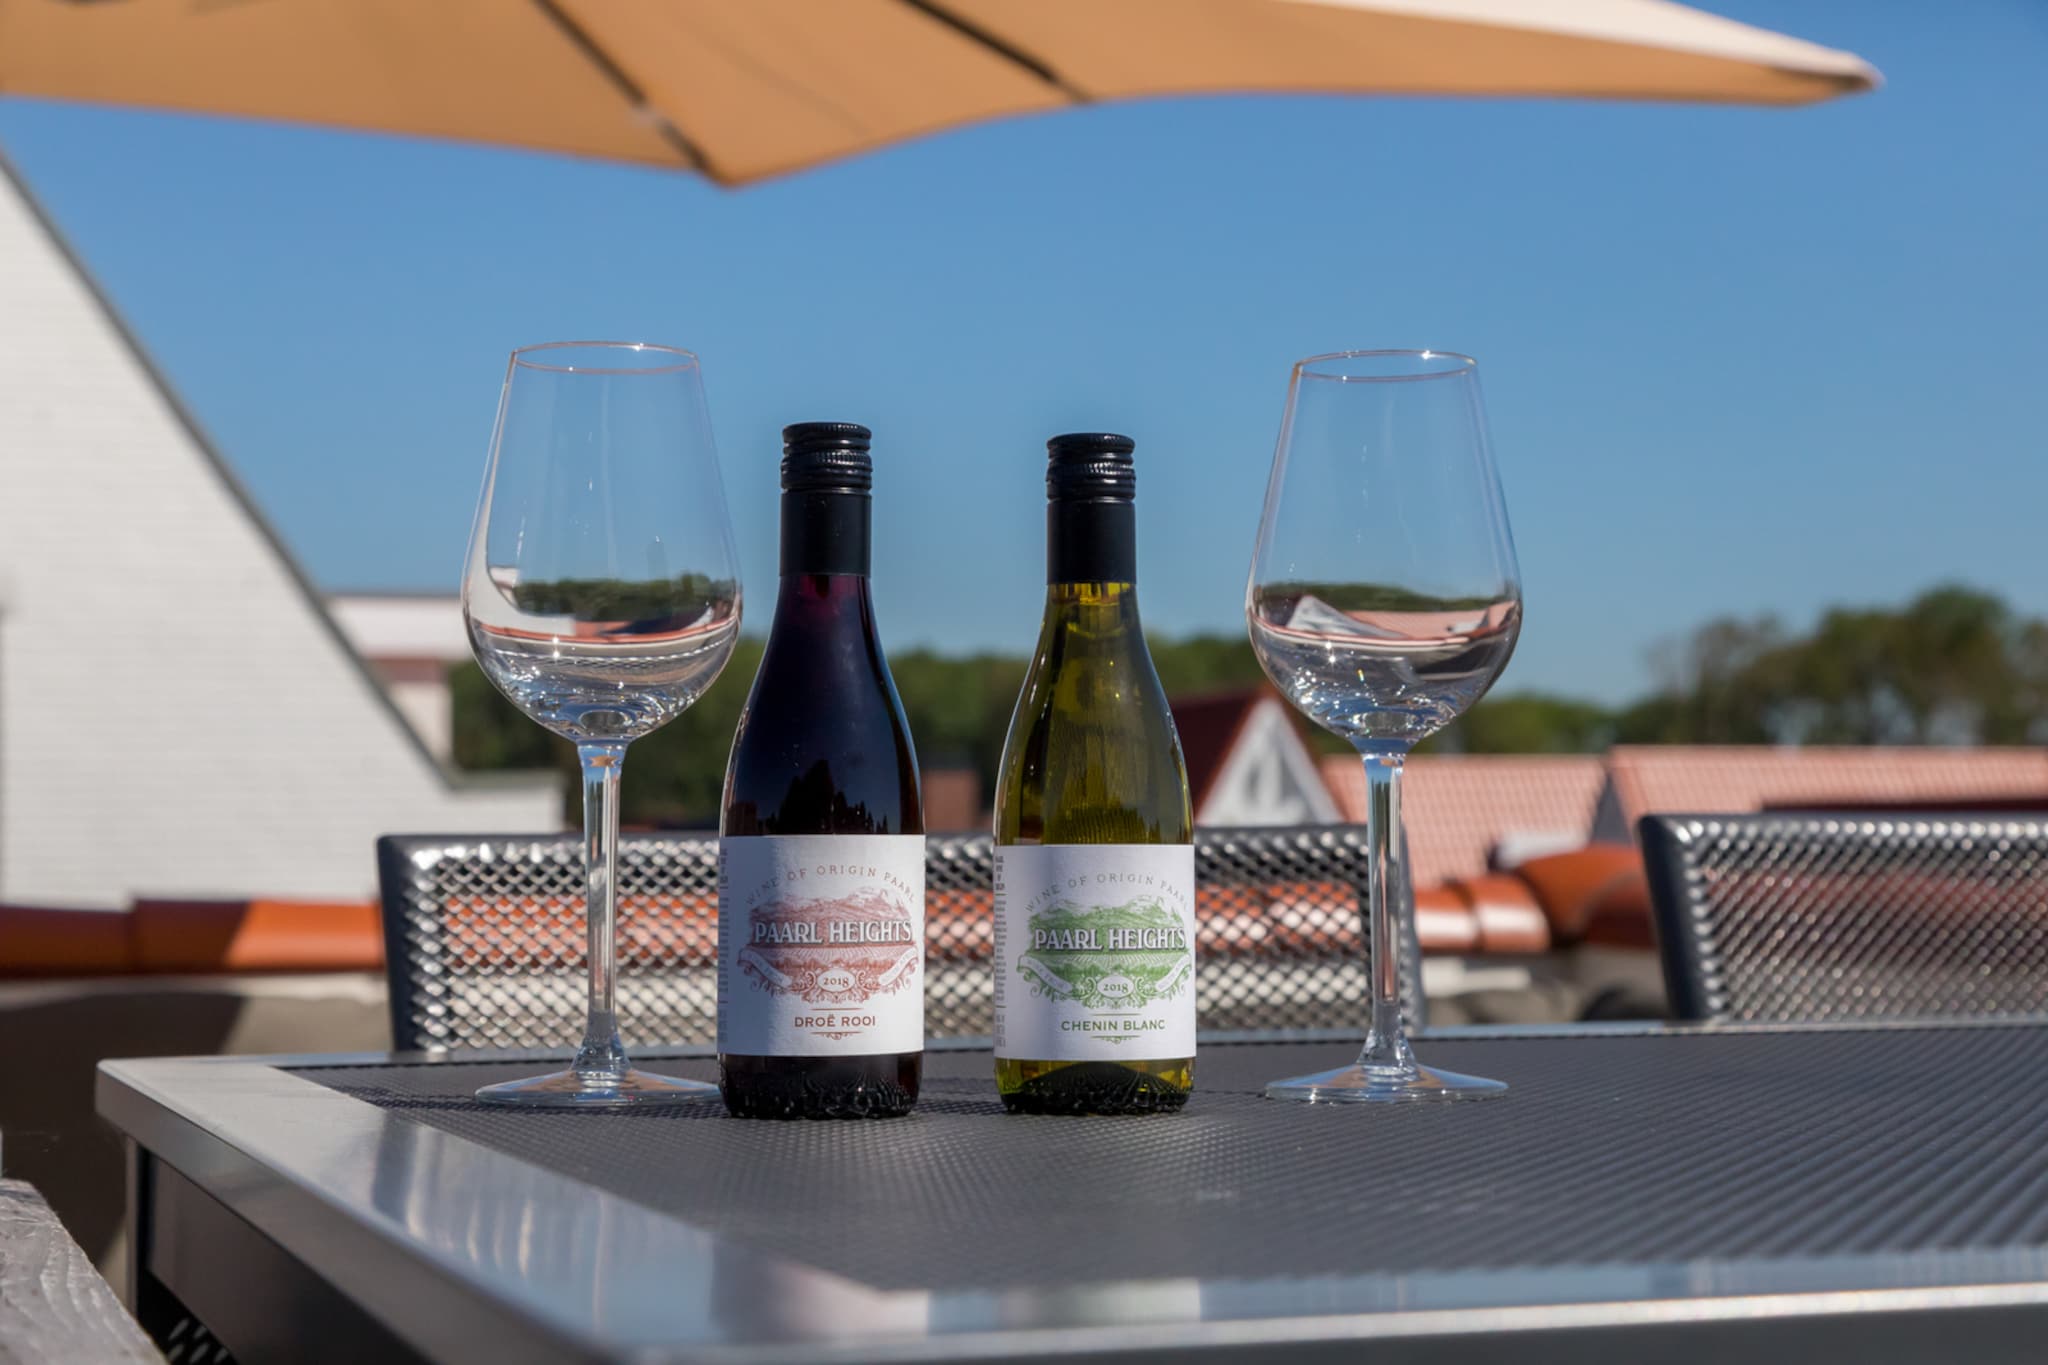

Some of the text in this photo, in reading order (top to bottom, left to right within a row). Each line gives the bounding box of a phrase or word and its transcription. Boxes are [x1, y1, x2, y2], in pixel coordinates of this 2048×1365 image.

[787, 868, 808, 881] OF
[816, 865, 877, 877] ORIGIN
[1025, 885, 1060, 912] WINE
[1068, 876, 1087, 887] OF
[1096, 872, 1154, 884] ORIGIN
[754, 920, 912, 944] PAARL HEIGHTS
[1034, 926, 1186, 950] PAARL HEIGHTS
[823, 976, 849, 986] 2018
[1103, 983, 1129, 993] 2018
[794, 1014, 876, 1028] DROË ROOI
[1061, 1019, 1165, 1031] CHENIN BLANC
